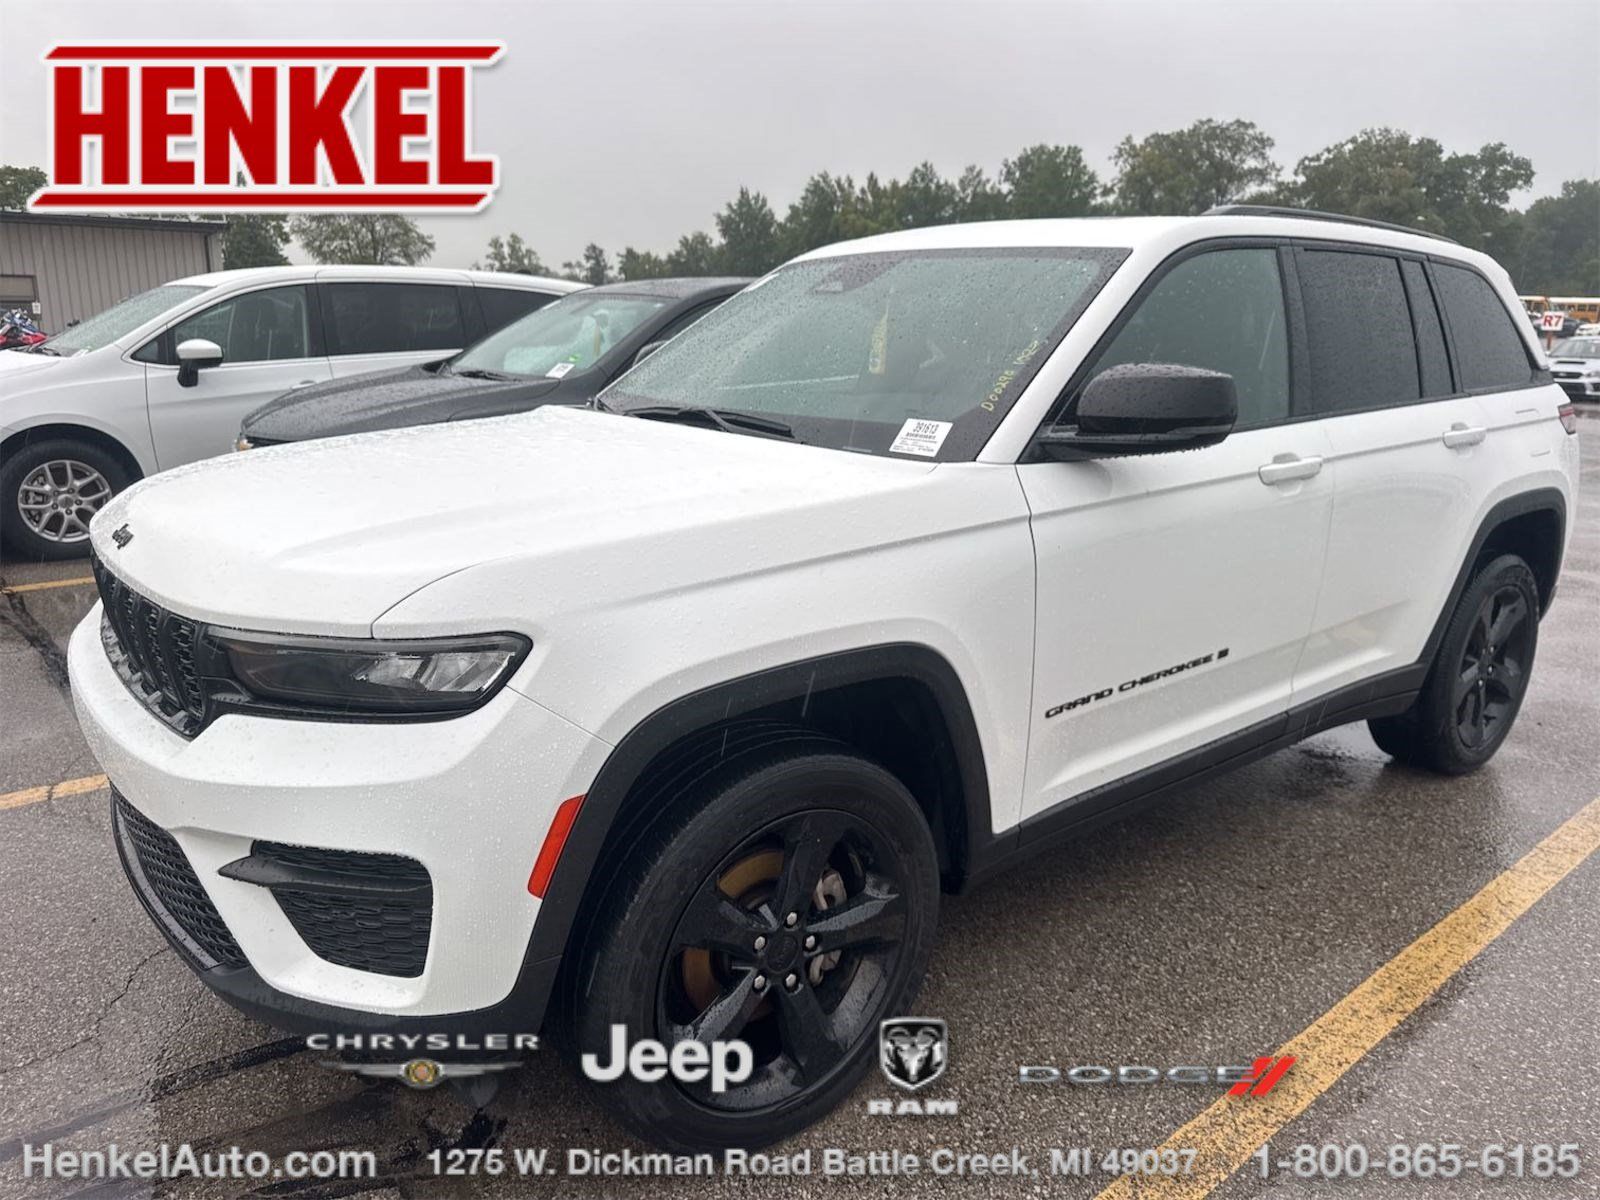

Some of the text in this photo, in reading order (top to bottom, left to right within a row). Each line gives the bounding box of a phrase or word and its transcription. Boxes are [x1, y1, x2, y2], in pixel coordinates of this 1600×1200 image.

[1543, 315, 1562, 327] R7
[1044, 652, 1215, 719] GRAND CHEROKEE
